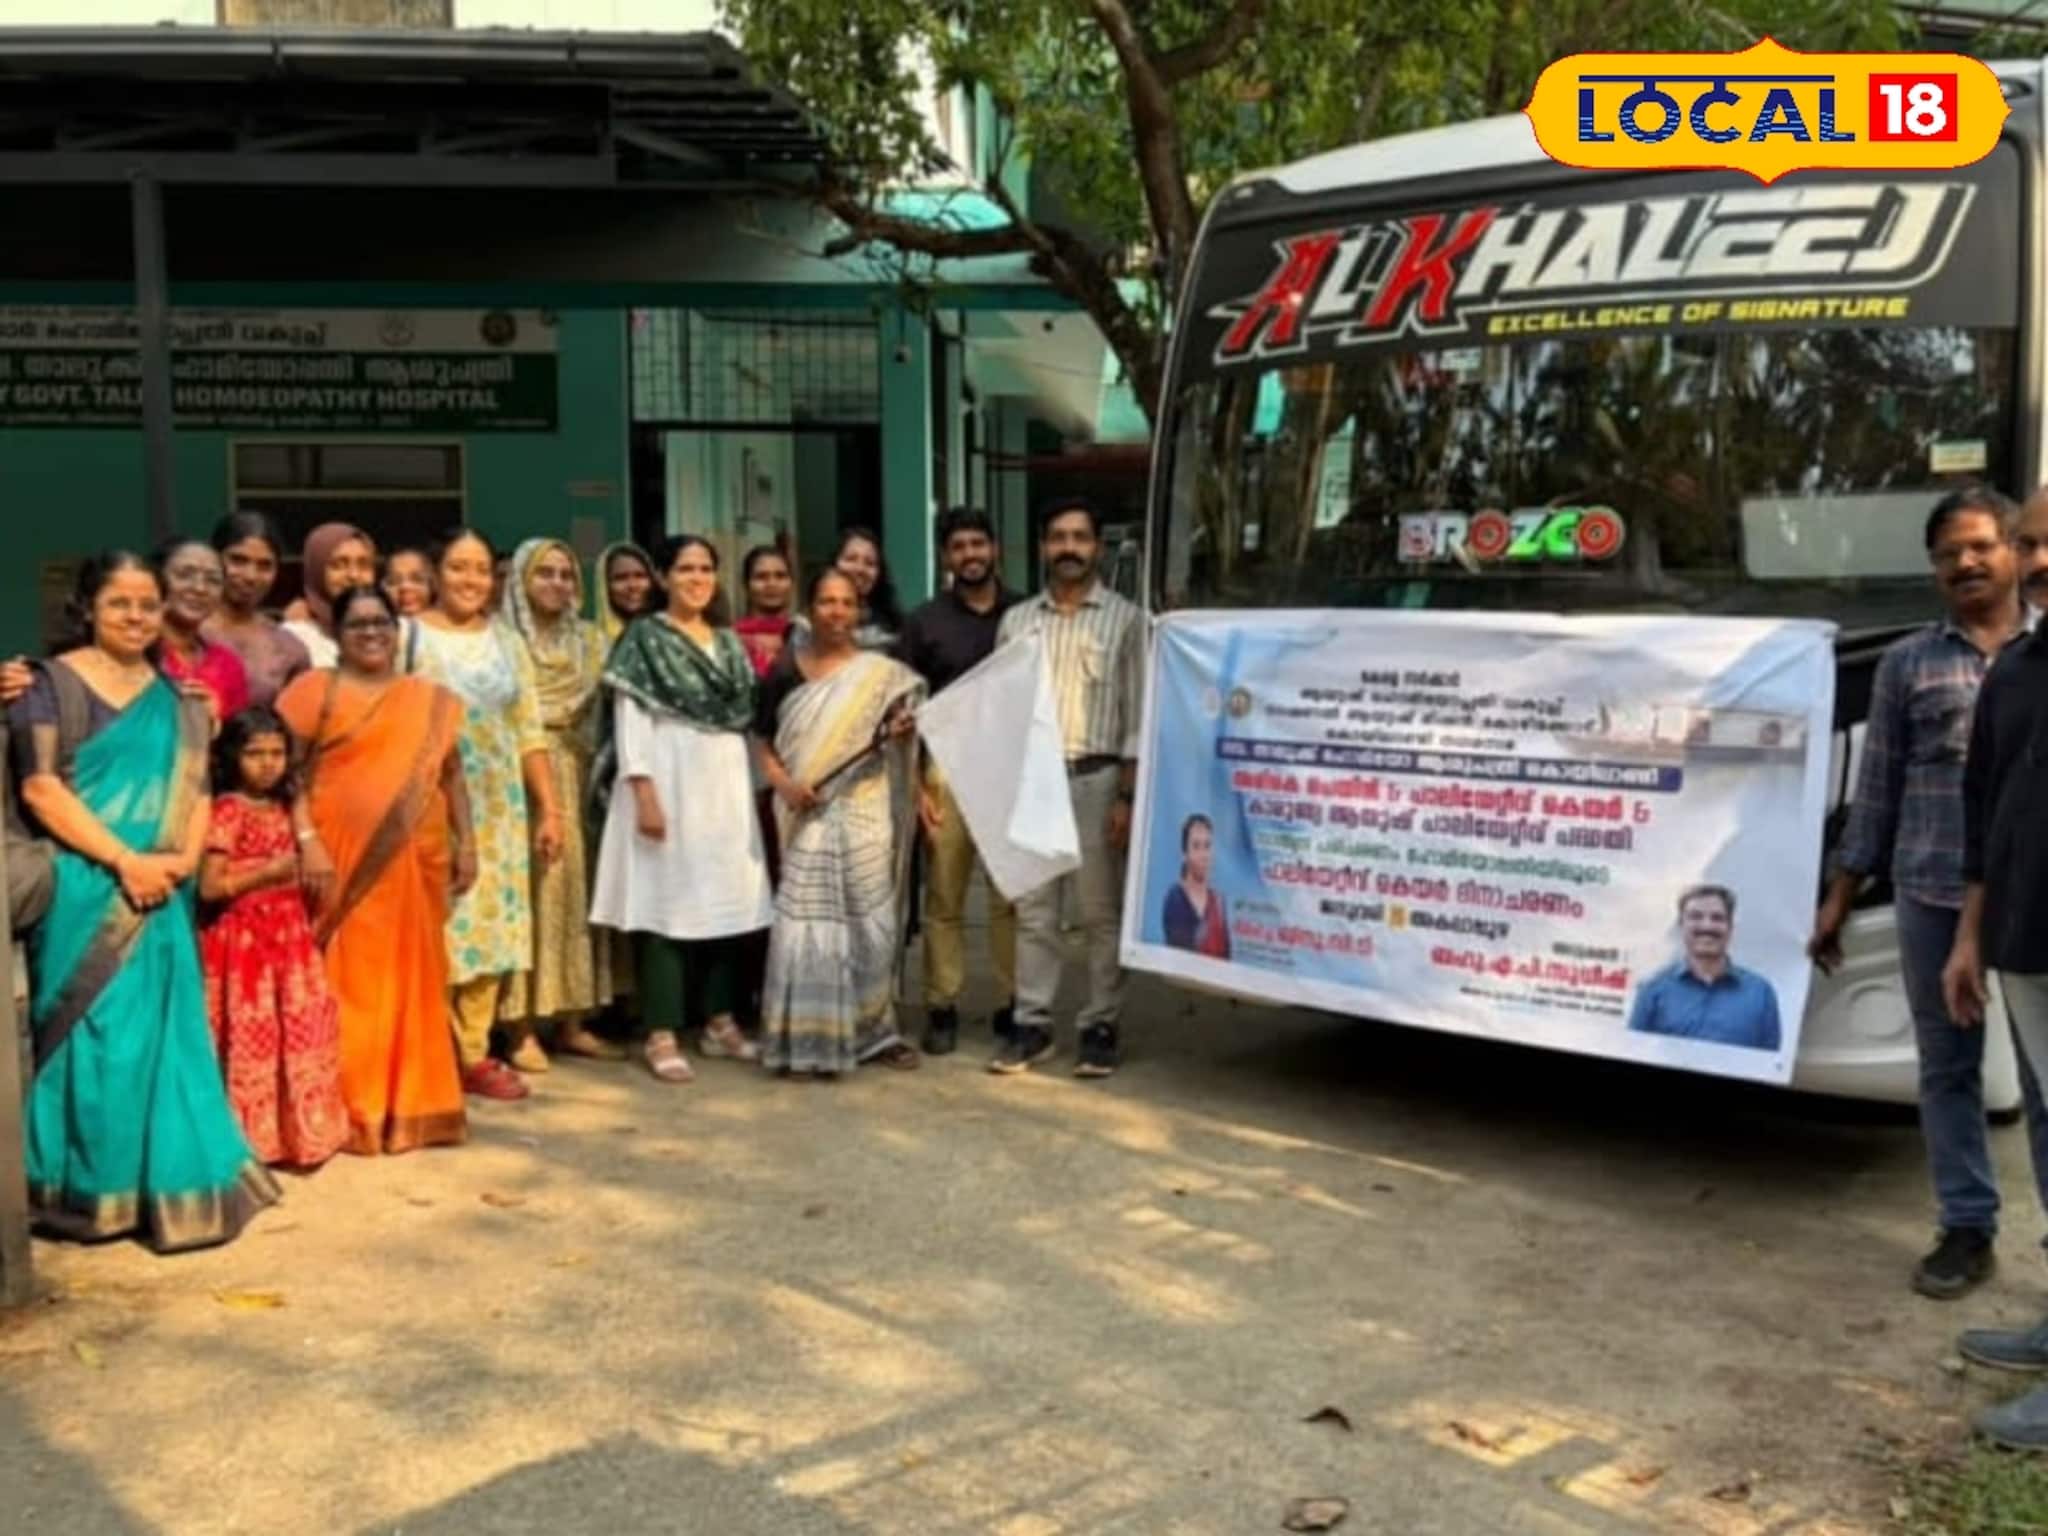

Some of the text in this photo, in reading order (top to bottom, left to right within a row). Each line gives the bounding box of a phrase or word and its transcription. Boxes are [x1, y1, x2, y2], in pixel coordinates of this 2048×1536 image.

[1488, 297, 1911, 335] EXCELLENCE OF SIGNATURE
[175, 386, 372, 409] HOMOEOPATHY
[376, 387, 500, 409] HOSPITAL
[1399, 505, 1625, 564] BROZCO
